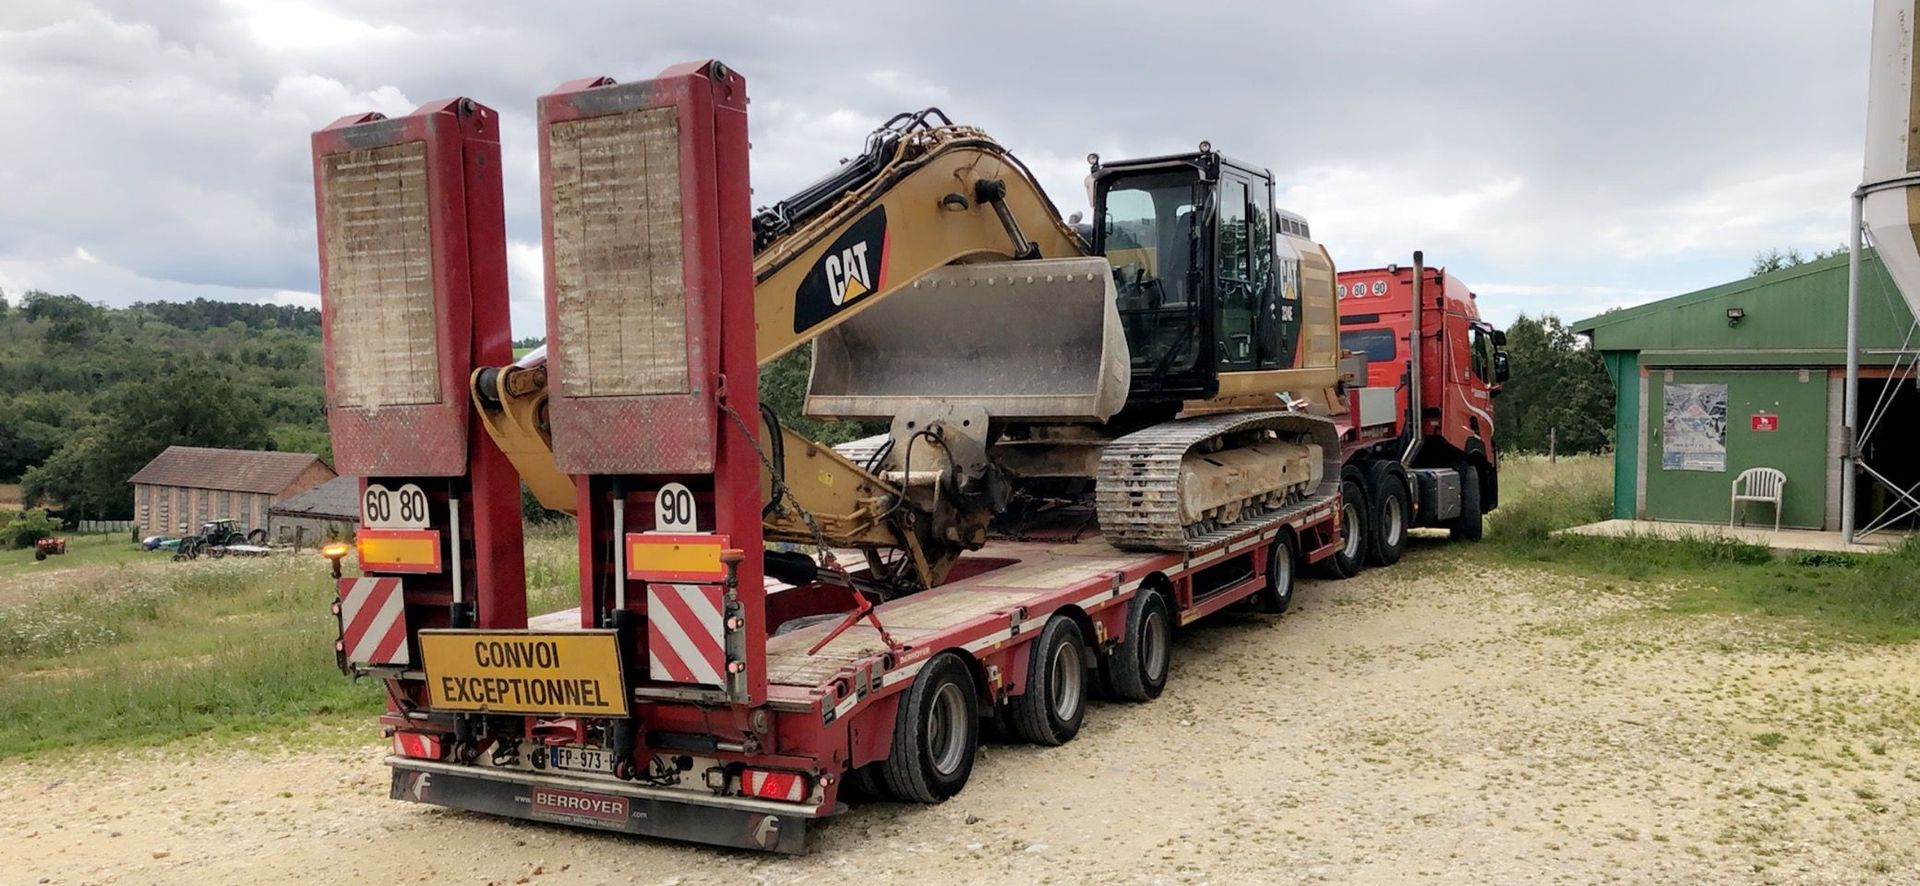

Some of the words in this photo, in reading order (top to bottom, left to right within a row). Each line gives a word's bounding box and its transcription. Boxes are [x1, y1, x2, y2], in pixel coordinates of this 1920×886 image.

[825, 240, 871, 306] CAT
[1279, 259, 1298, 299] CAT
[1354, 284, 1365, 296] 80
[1374, 282, 1385, 294] 90
[366, 490, 391, 522] 60
[400, 490, 424, 522] 80
[660, 489, 691, 525] 90
[475, 641, 560, 669] CONVOI
[441, 676, 609, 707] EXCEPTIONNEL
[536, 792, 623, 815] BERROYER
[632, 810, 648, 819] .com
